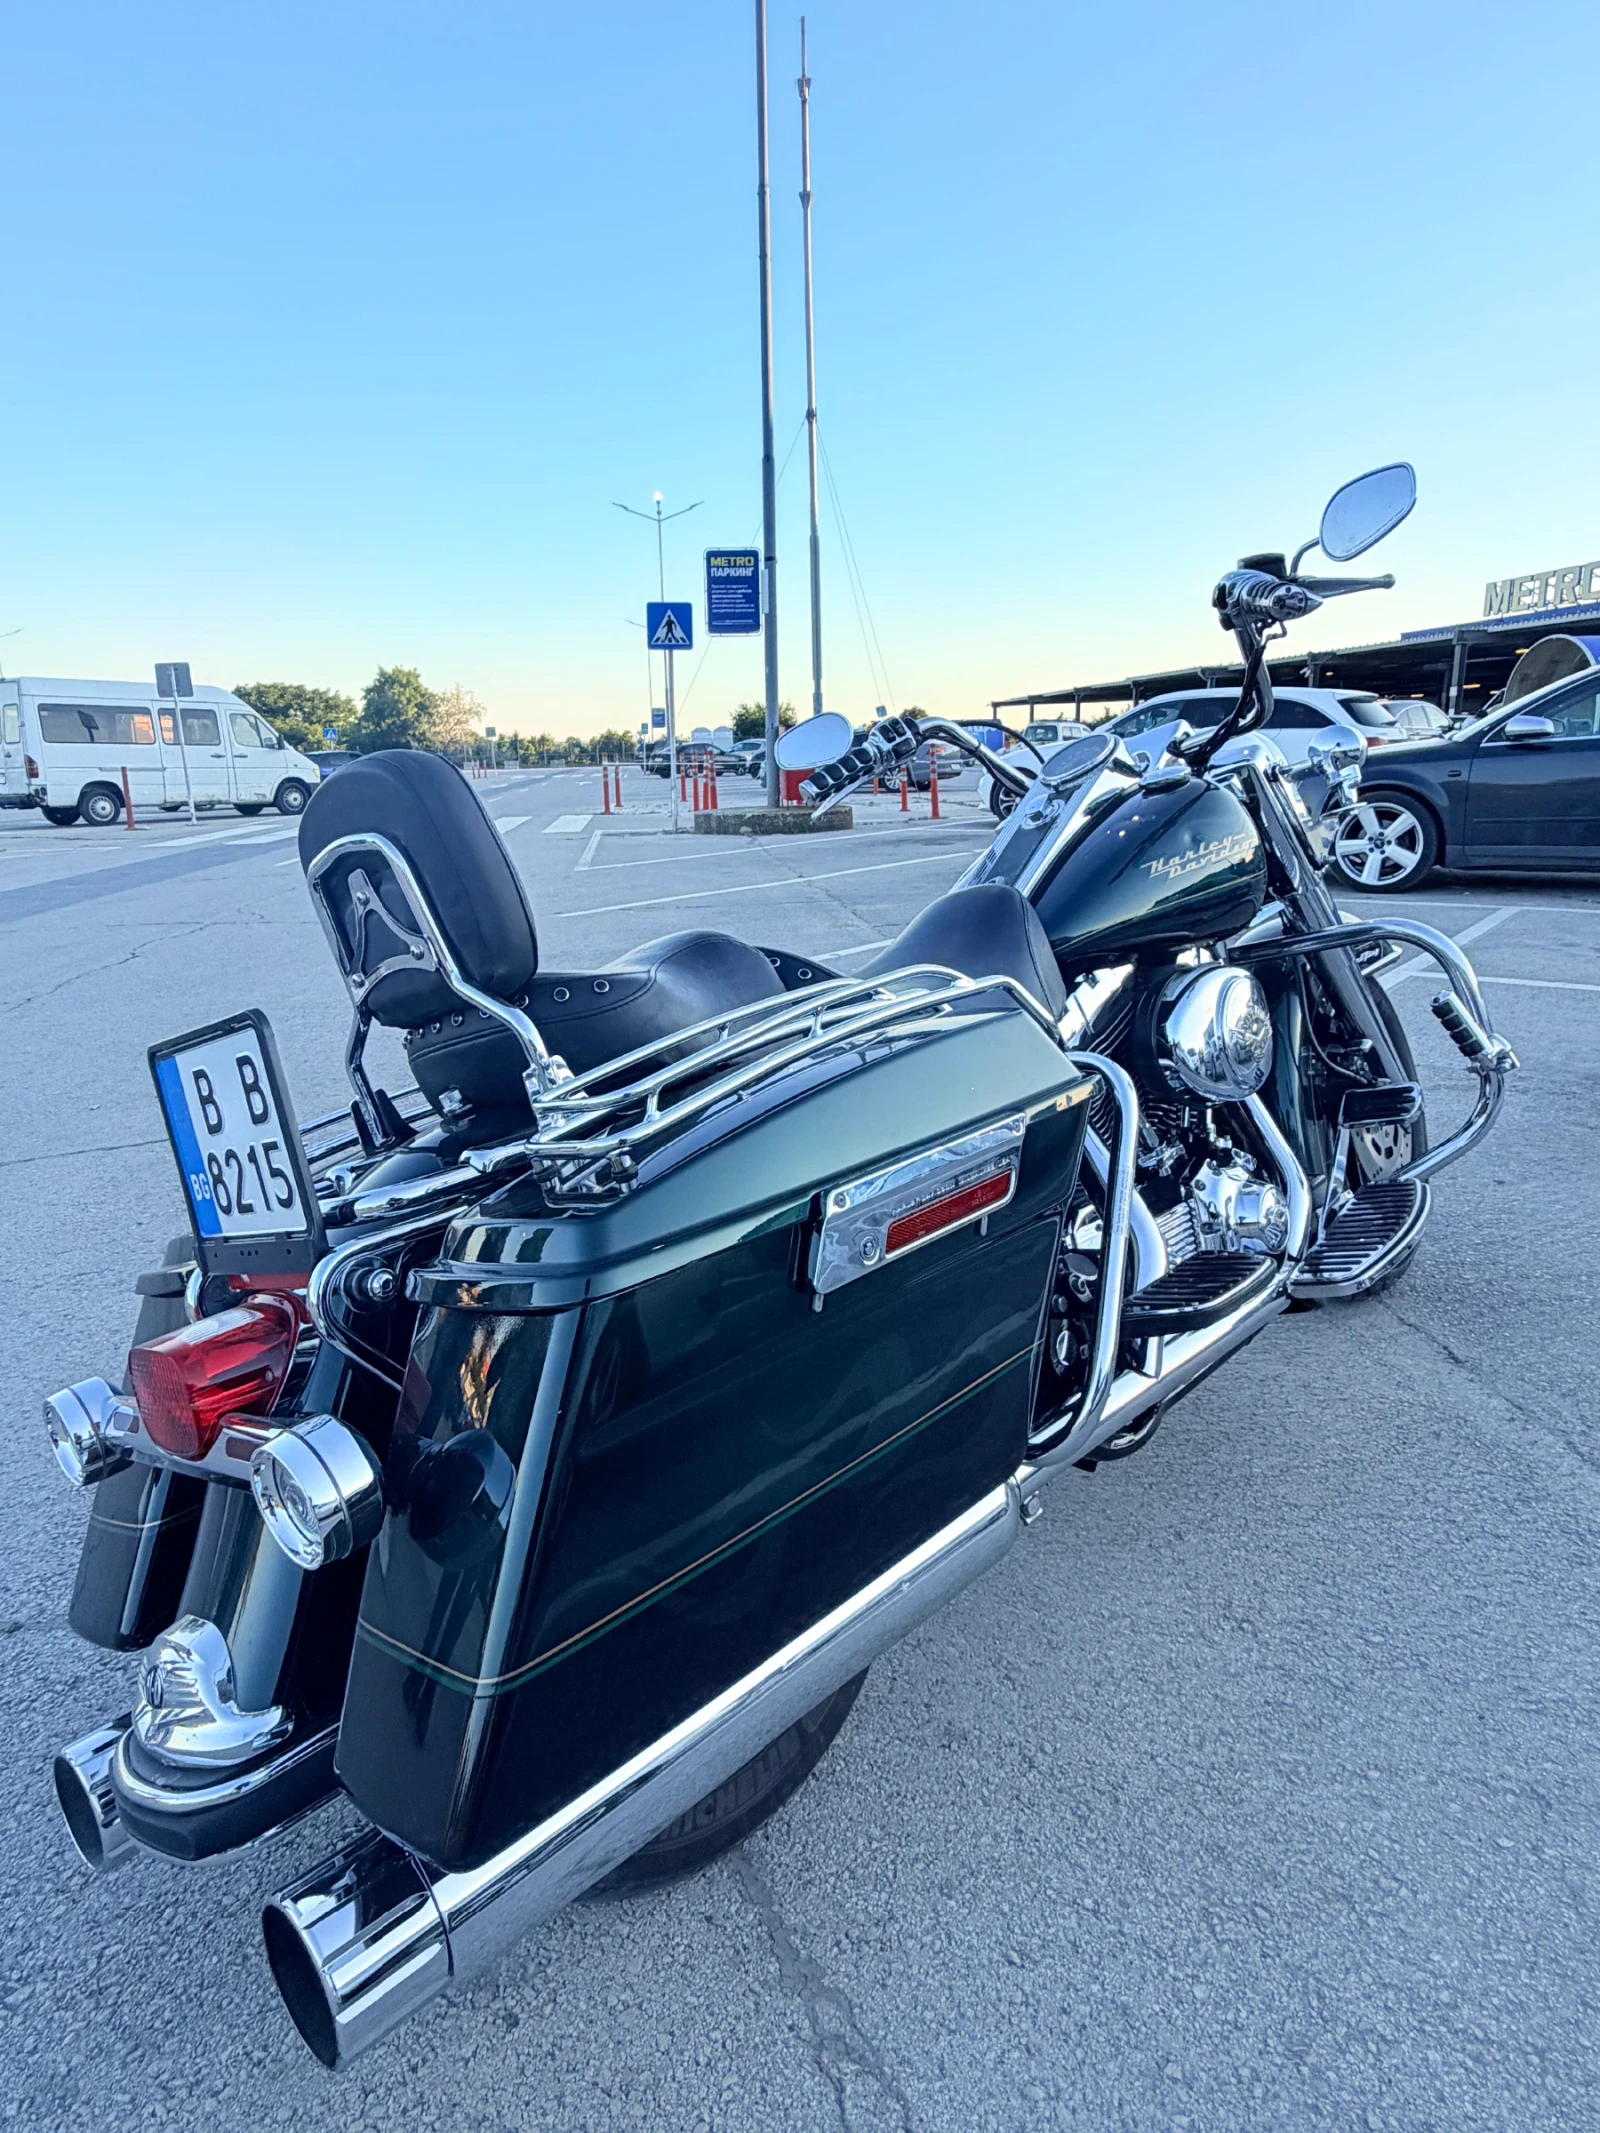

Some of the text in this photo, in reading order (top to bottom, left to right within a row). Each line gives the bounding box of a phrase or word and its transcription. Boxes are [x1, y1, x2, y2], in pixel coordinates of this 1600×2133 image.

[710, 556, 755, 567] METRO
[710, 567, 755, 577] ПАРКИНГ
[192, 1054, 269, 1135] B B
[190, 1173, 211, 1202] BG
[207, 1140, 294, 1216] 8215
